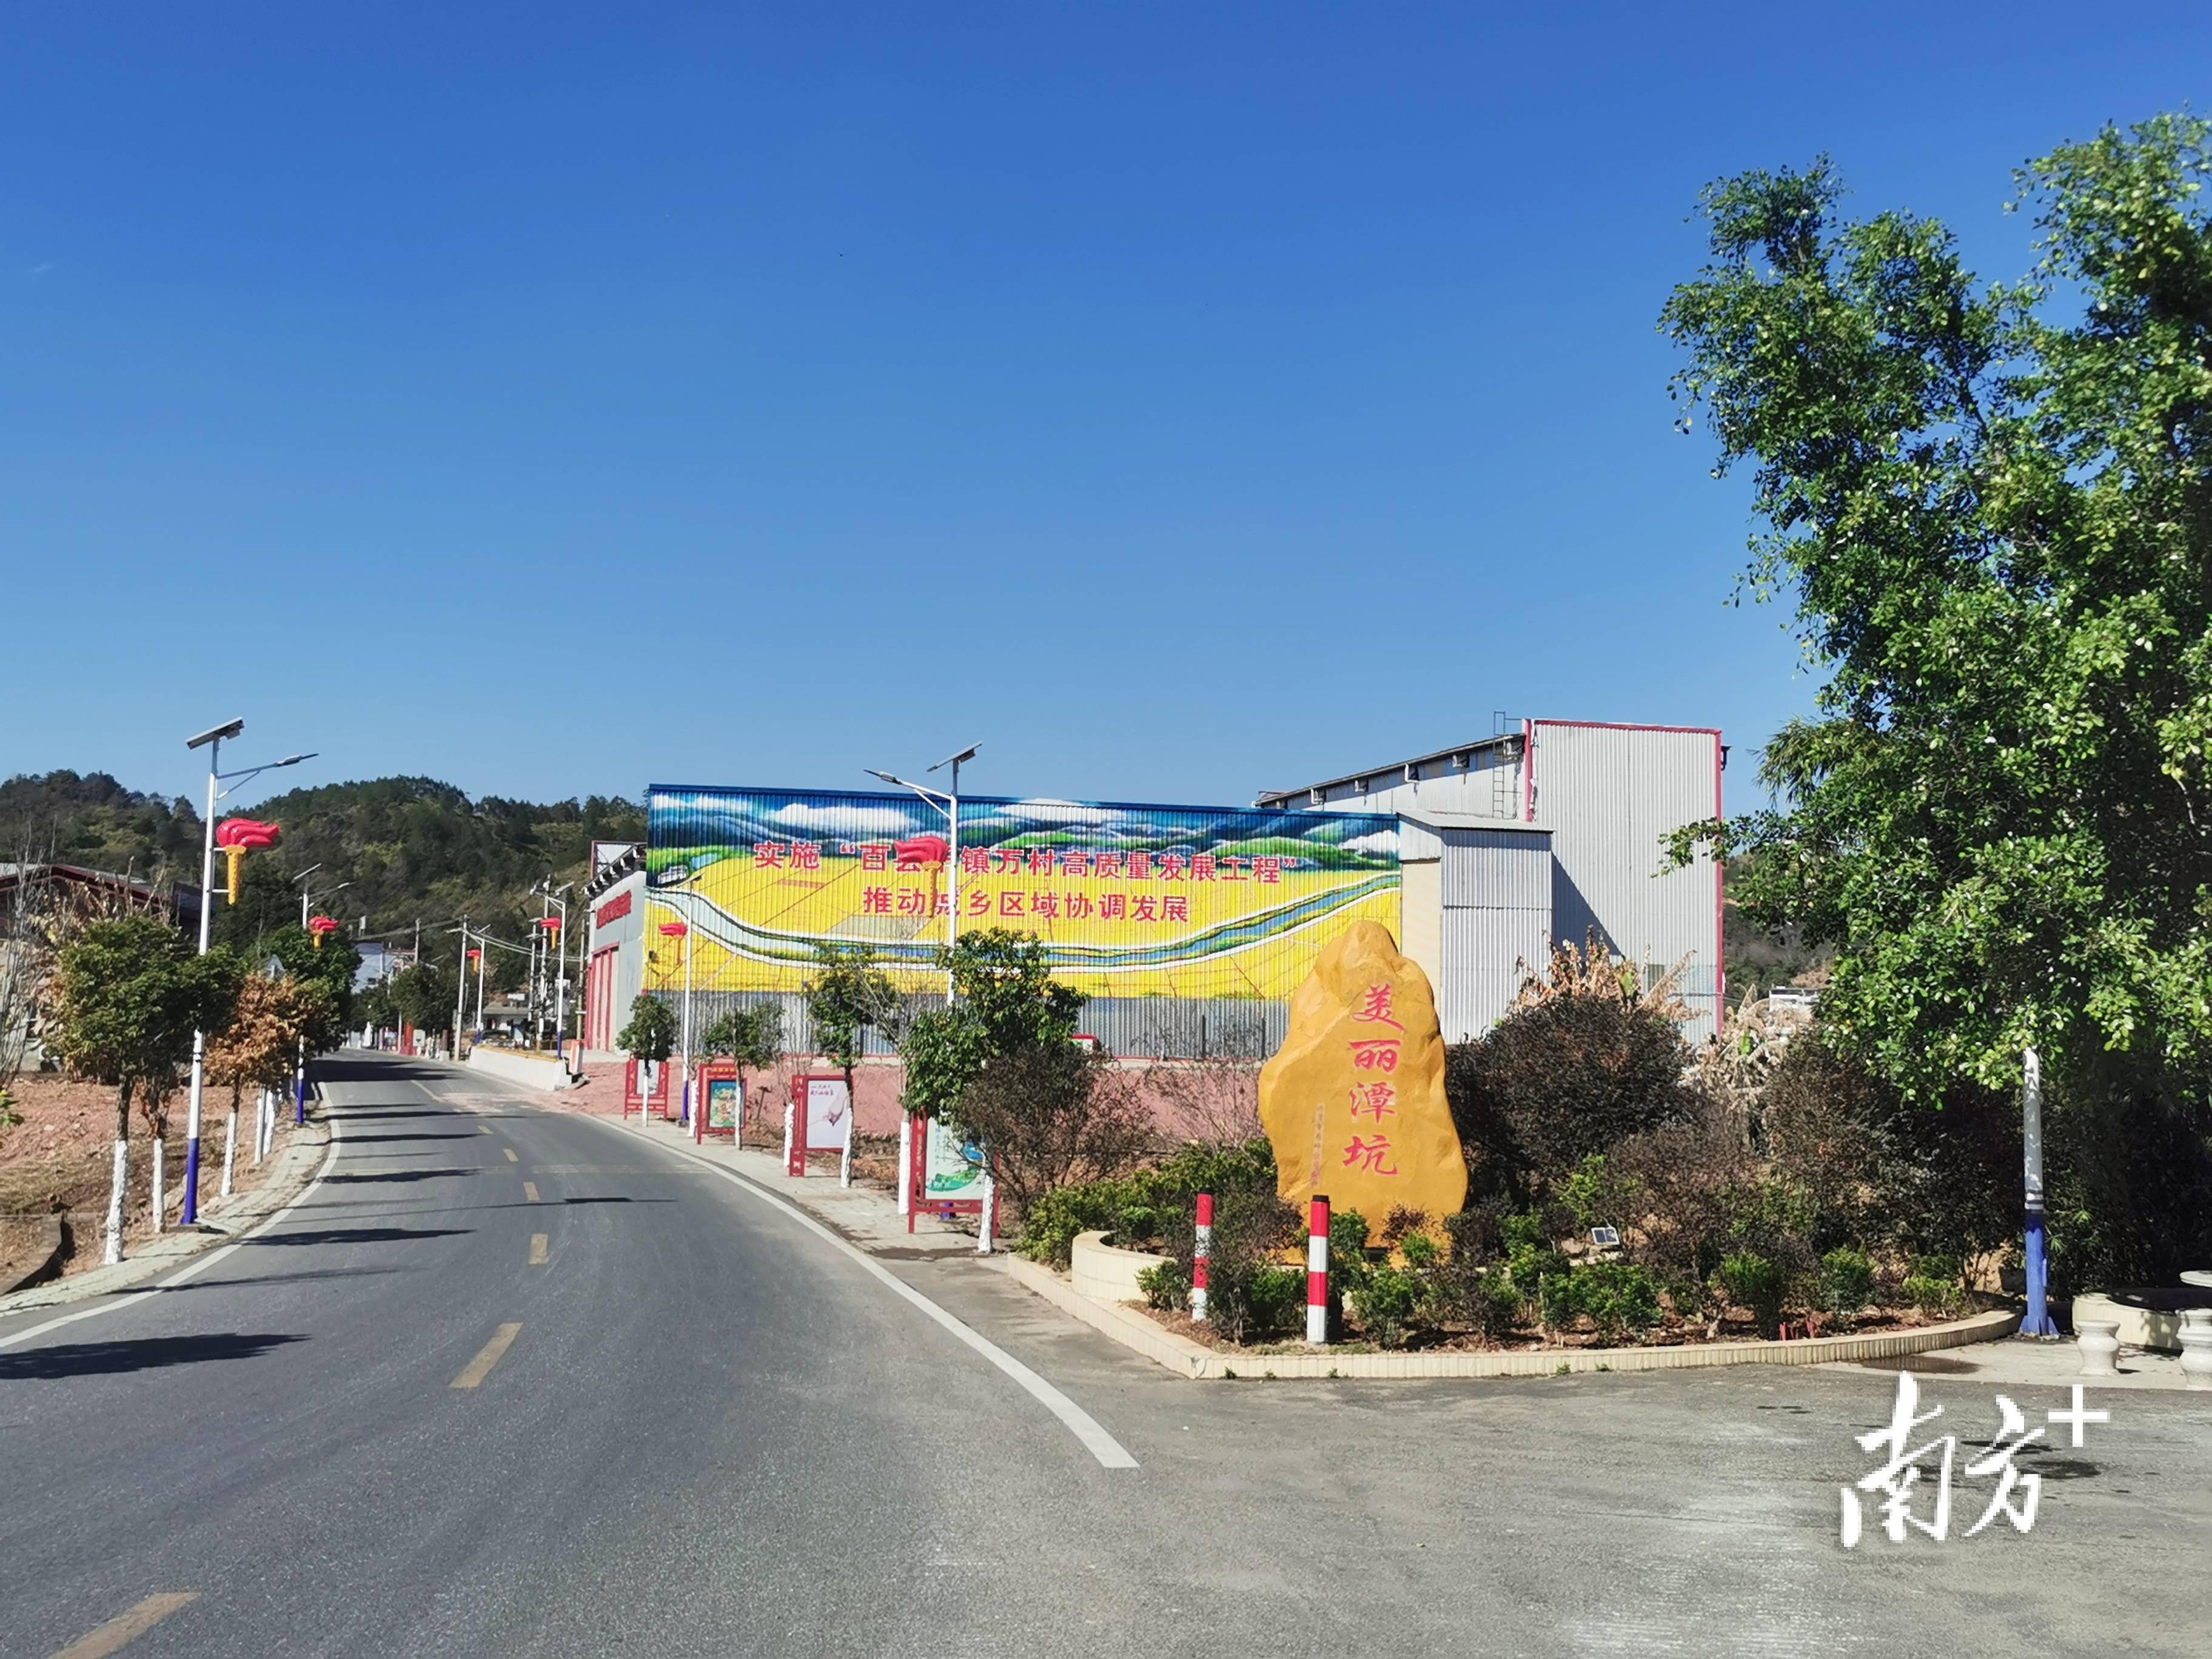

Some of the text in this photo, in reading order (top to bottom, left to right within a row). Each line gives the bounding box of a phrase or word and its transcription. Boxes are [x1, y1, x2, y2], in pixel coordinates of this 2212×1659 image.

[754, 840, 1295, 883] 实施“百镇万村高质量发展工程”
[1343, 984, 1405, 1175] 美丽潭坑
